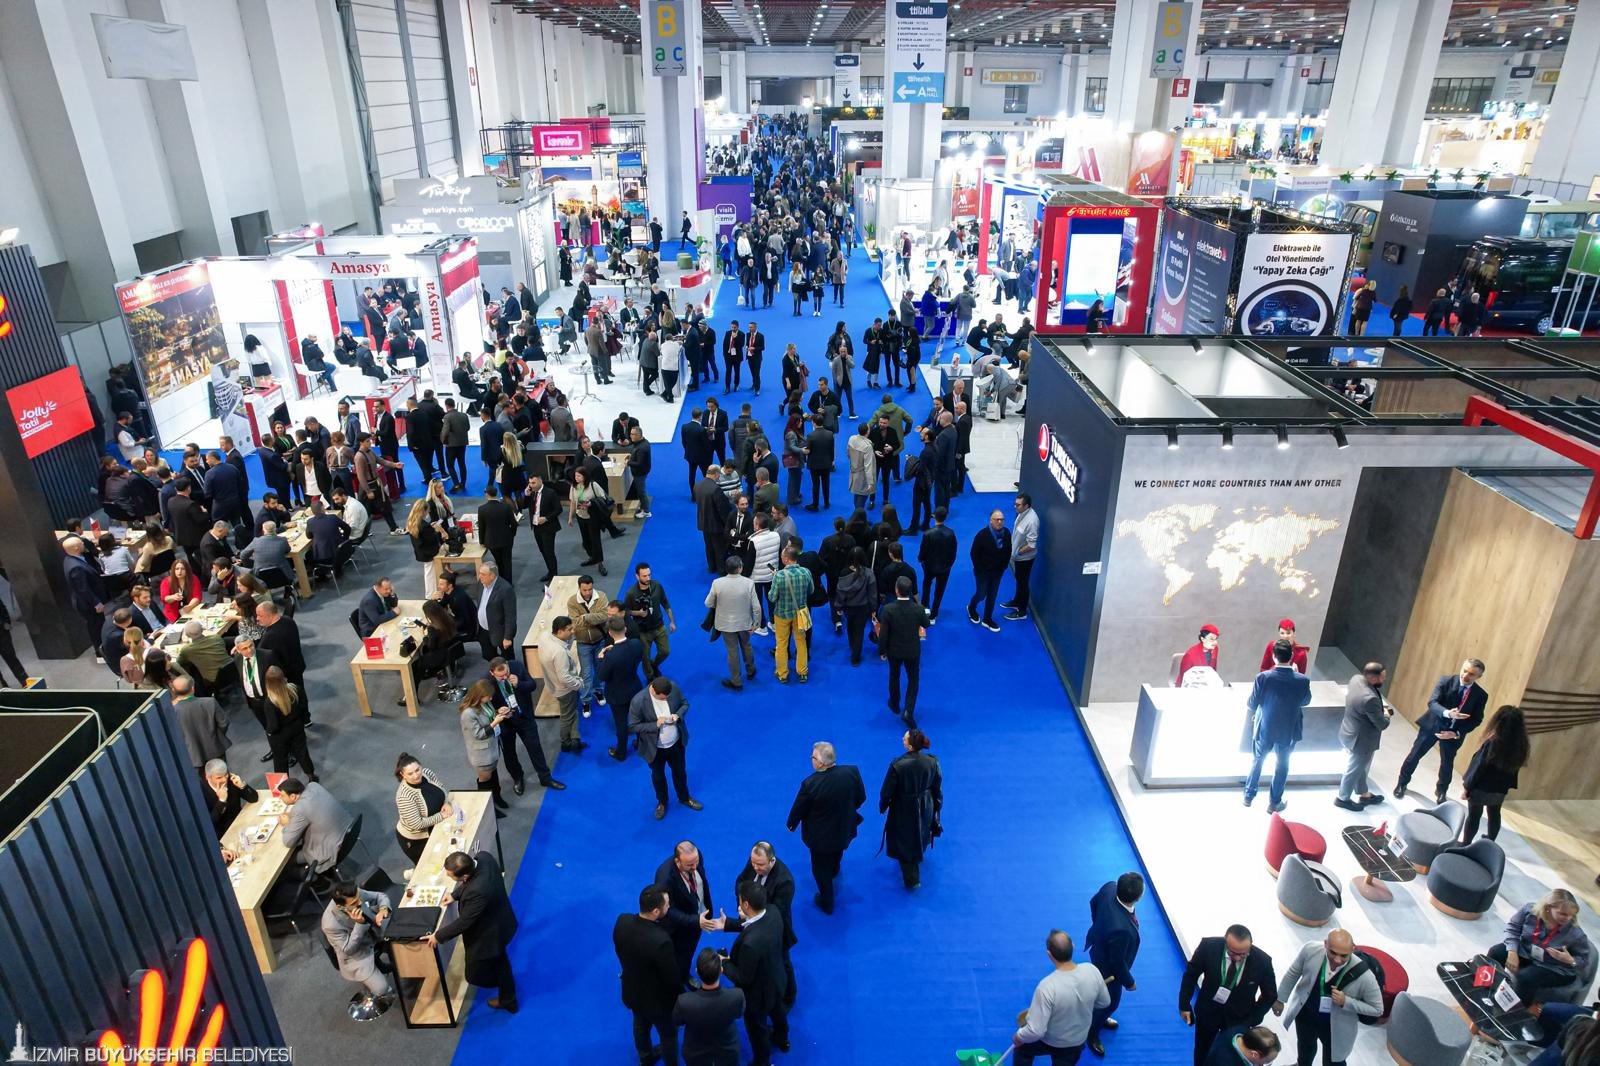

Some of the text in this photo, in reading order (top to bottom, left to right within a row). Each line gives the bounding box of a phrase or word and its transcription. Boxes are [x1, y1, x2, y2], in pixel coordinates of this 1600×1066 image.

[657, 5, 677, 37] B
[1163, 6, 1183, 38] B
[655, 47, 683, 61] a c
[1156, 48, 1183, 63] a c
[918, 86, 927, 97] A
[1273, 244, 1322, 252] Elektraweb ile
[330, 261, 391, 276] Amasya
[1286, 265, 1308, 275] Zeka
[426, 281, 443, 343] Amasya
[169, 355, 213, 388] AMASYA
[20, 406, 50, 421] Jolly
[1051, 435, 1078, 485] TURKISH
[1048, 455, 1075, 504] AIRLINES
[1134, 479, 1342, 488] WE CONNECT MORE COUNTRIES THAN ANY OTHER
